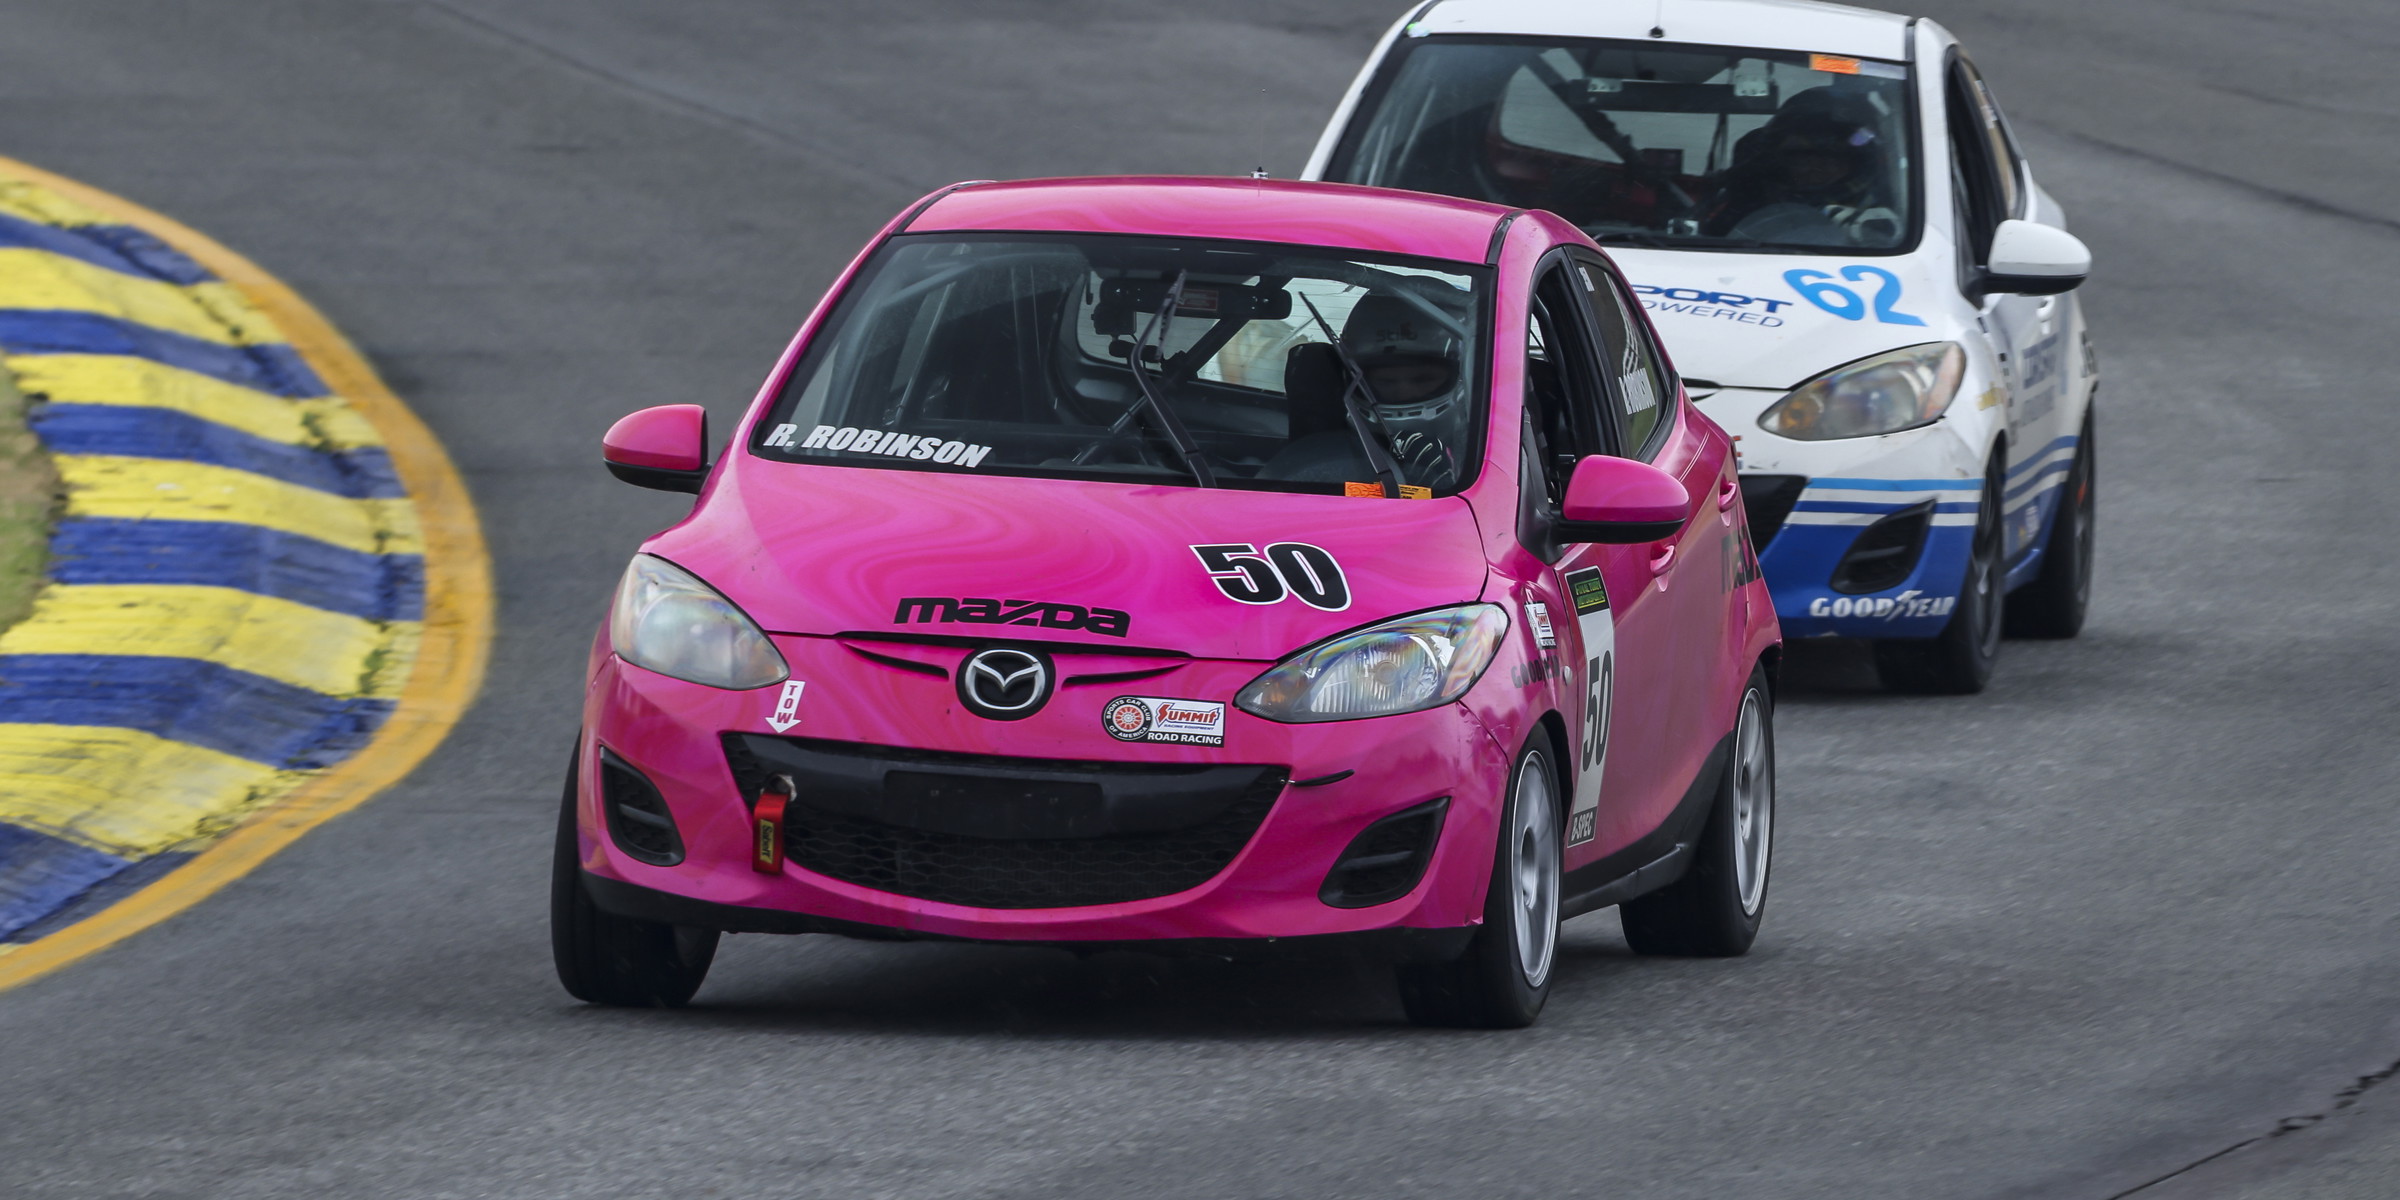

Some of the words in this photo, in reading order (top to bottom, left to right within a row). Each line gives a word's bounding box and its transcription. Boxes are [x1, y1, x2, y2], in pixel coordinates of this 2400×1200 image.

[1782, 264, 1930, 327] 62
[763, 423, 797, 447] R.
[801, 425, 992, 468] ROBINSON
[1189, 542, 1351, 612] 50
[1809, 589, 1956, 623] GOODYEAR
[776, 685, 798, 724] TOW
[1106, 700, 1124, 720] SPORTS
[1126, 698, 1141, 706] CAR
[1140, 704, 1151, 721] CLUB
[1583, 650, 1612, 772] 50
[1109, 725, 1118, 733] OF
[1118, 726, 1148, 739] AMERICA
[1147, 732, 1179, 742] ROAD
[1180, 734, 1222, 745] RACING
